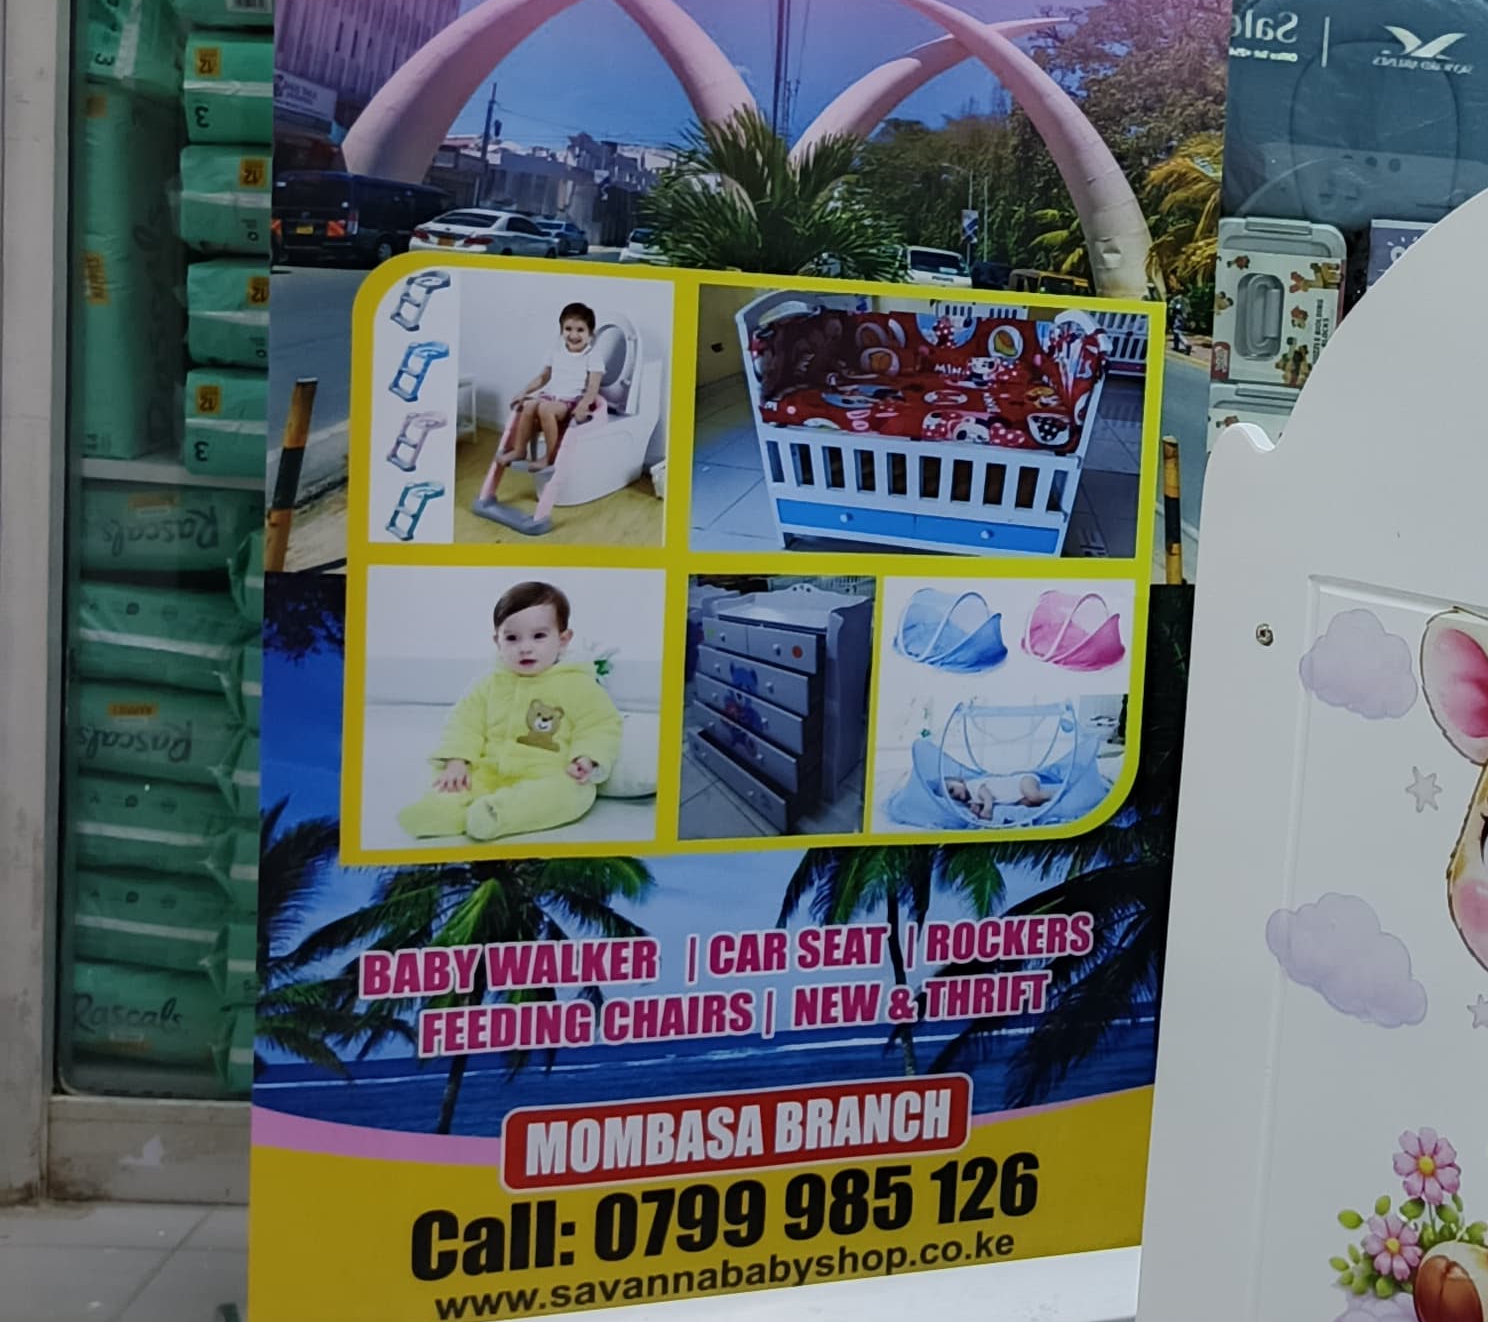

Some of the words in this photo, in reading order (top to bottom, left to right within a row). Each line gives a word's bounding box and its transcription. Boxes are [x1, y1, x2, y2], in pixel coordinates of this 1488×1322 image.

[359, 943, 478, 999] BABY
[485, 935, 661, 991] WALKER
[706, 929, 787, 977] CAR
[797, 923, 889, 971] SEAT
[924, 911, 1094, 965] ROCKERS
[418, 999, 594, 1059] FEEDING
[600, 989, 754, 1044] CHAIRS
[794, 982, 881, 1030] NEW
[886, 981, 914, 1022] &
[925, 970, 1051, 1022] THRIFT
[524, 1102, 766, 1179] MOMBASA
[773, 1086, 953, 1155] BRANCH
[410, 1200, 578, 1283] Call:
[593, 1183, 767, 1263] 0799
[784, 1164, 914, 1239] 985
[929, 1152, 1040, 1225] 126
[433, 1229, 1016, 1322] www.savannababyshop.co.ke
